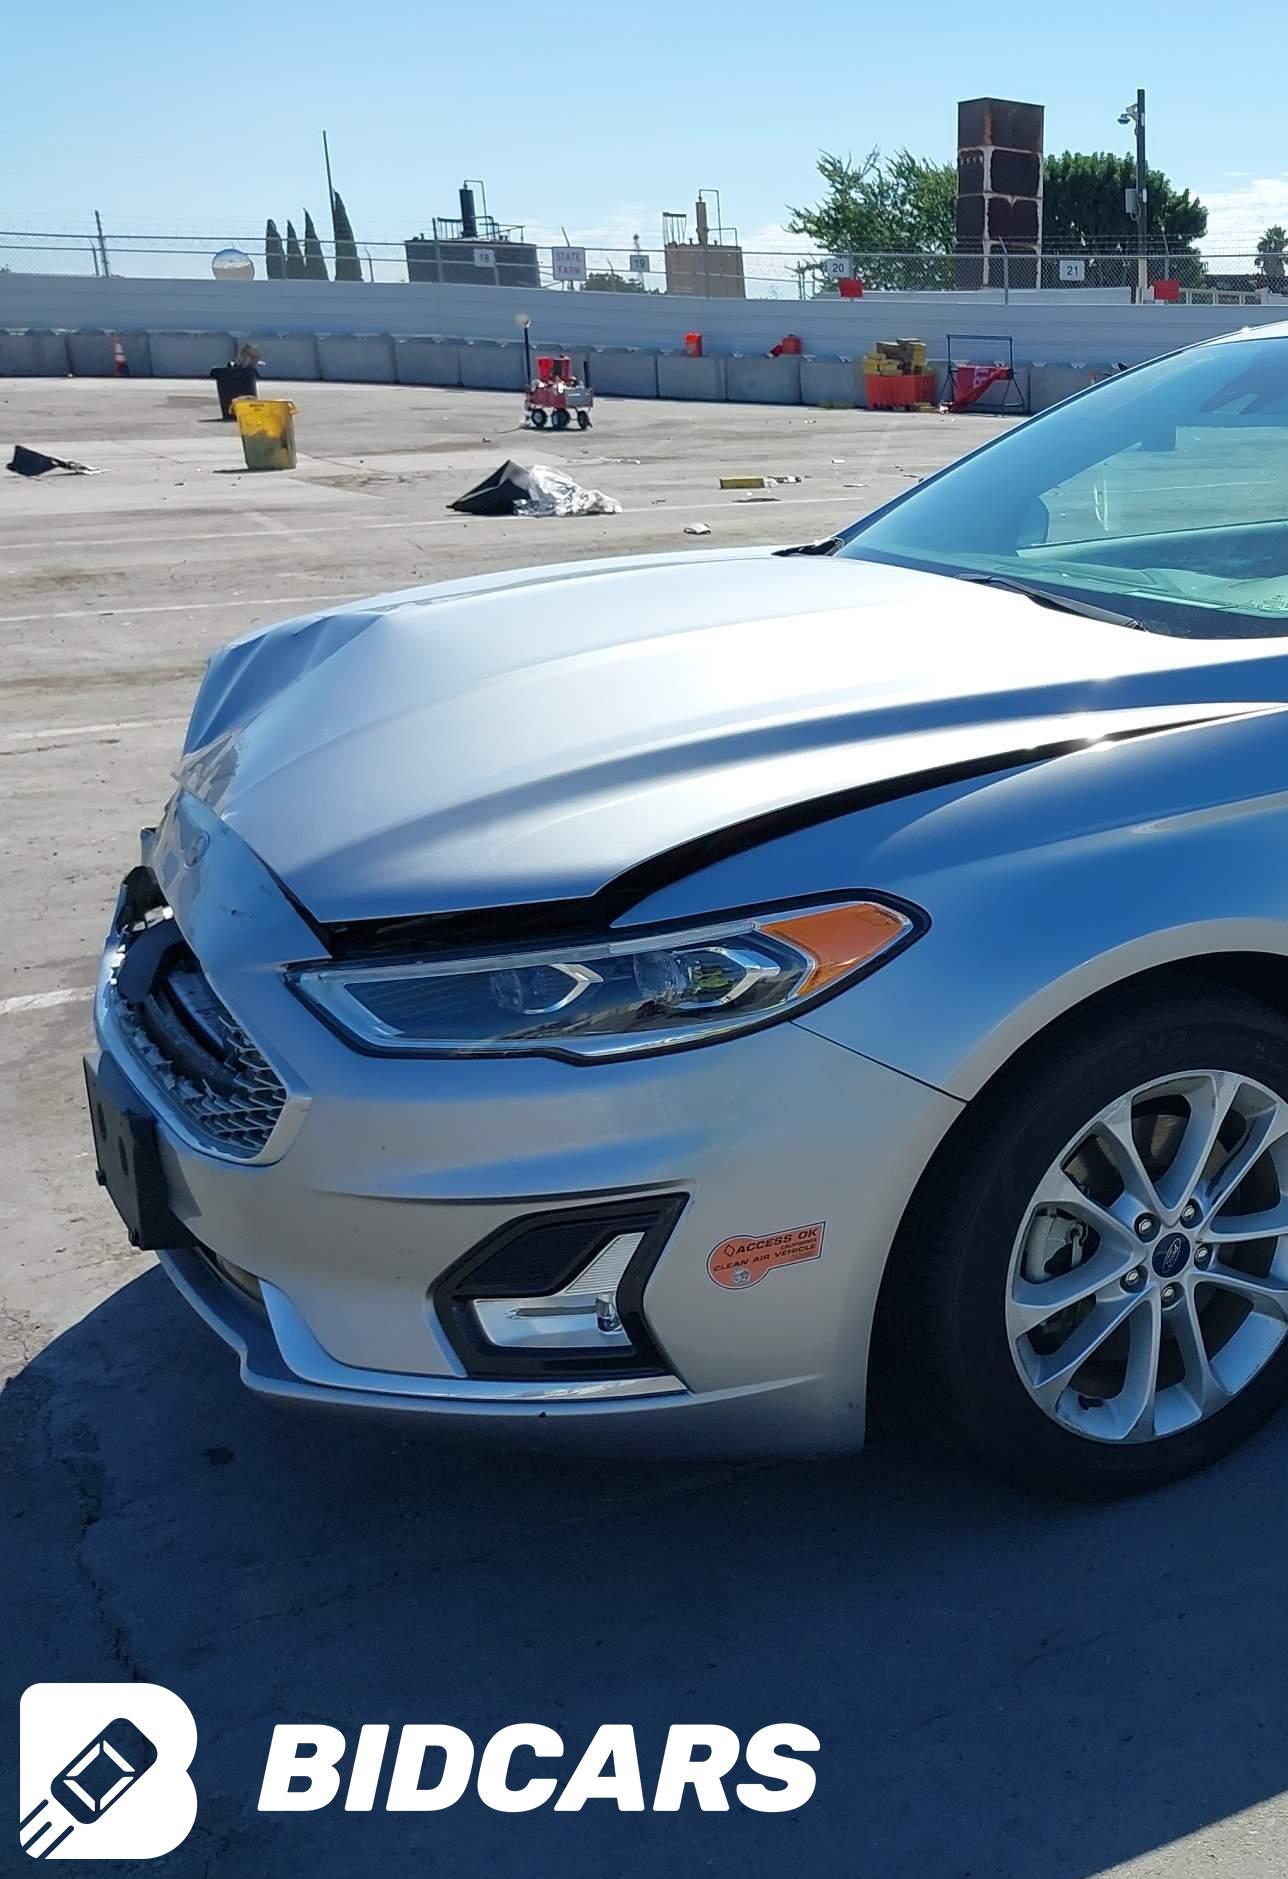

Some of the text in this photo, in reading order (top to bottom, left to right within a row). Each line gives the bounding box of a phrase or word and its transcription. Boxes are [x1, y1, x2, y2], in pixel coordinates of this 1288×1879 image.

[556, 252, 580, 263] STATE
[558, 265, 580, 273] FARM
[635, 258, 646, 270] 19
[832, 263, 845, 273] 20
[1066, 265, 1078, 276] 21
[735, 1228, 817, 1255] ACCESS OK
[713, 1259, 749, 1273] CLEAN
[752, 1253, 770, 1263] AIR
[774, 1243, 816, 1258] VEHICLE
